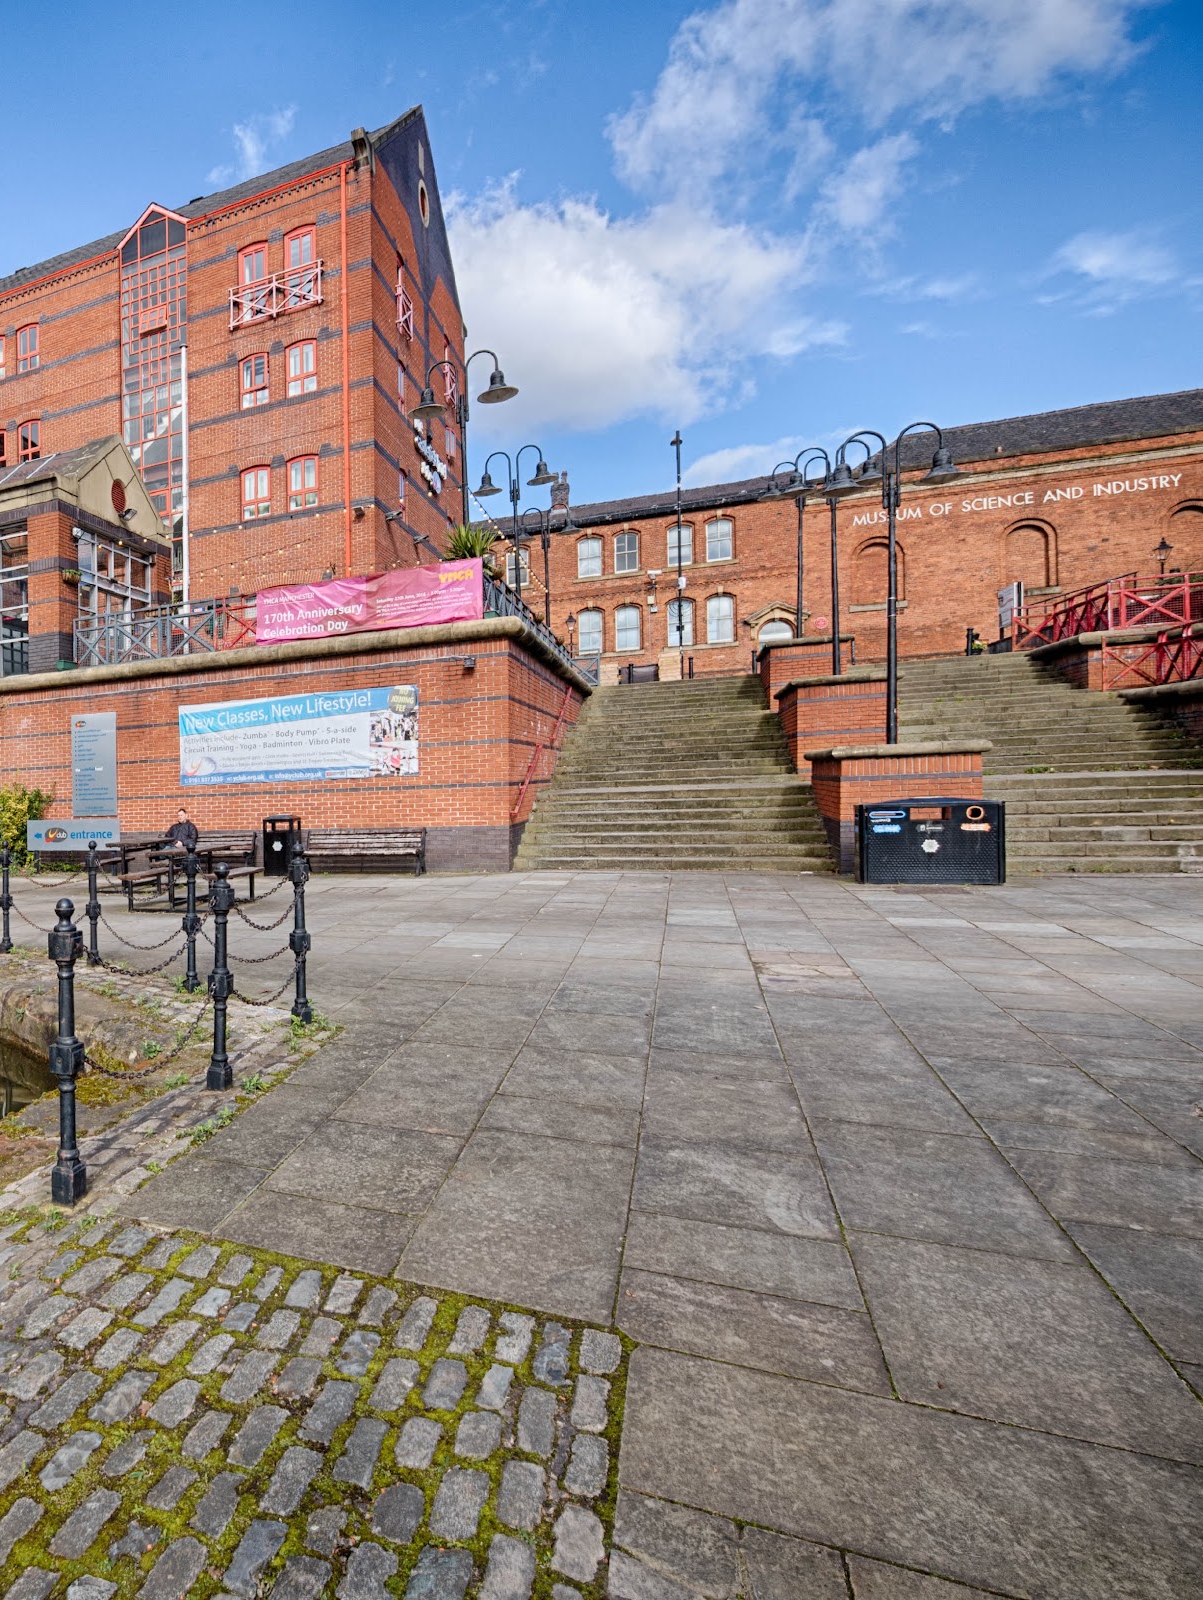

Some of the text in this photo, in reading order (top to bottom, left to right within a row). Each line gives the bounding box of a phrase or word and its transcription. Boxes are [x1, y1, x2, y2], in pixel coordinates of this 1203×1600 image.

[852, 473, 1183, 527] MUSUM OF SCIENCE AND INDUSTRY
[439, 569, 474, 584] YMCA
[263, 592, 315, 605] YMCA MANCHESTER
[264, 611, 294, 624] 170th
[297, 603, 363, 620] Anniversary
[263, 620, 348, 638] Celebration Day
[390, 695, 414, 704] JOINING
[185, 691, 372, 730] New Classes, New Lifestyle!
[395, 704, 406, 712] FEE
[184, 735, 213, 744] Activities
[275, 729, 295, 739] Body
[326, 725, 357, 734] 5-a-side
[184, 745, 205, 754] Circuit
[207, 743, 234, 753] Training
[240, 743, 257, 751] Yoga
[262, 740, 303, 748] Badminton
[308, 738, 329, 746] Vibro
[70, 830, 113, 839] entrance
